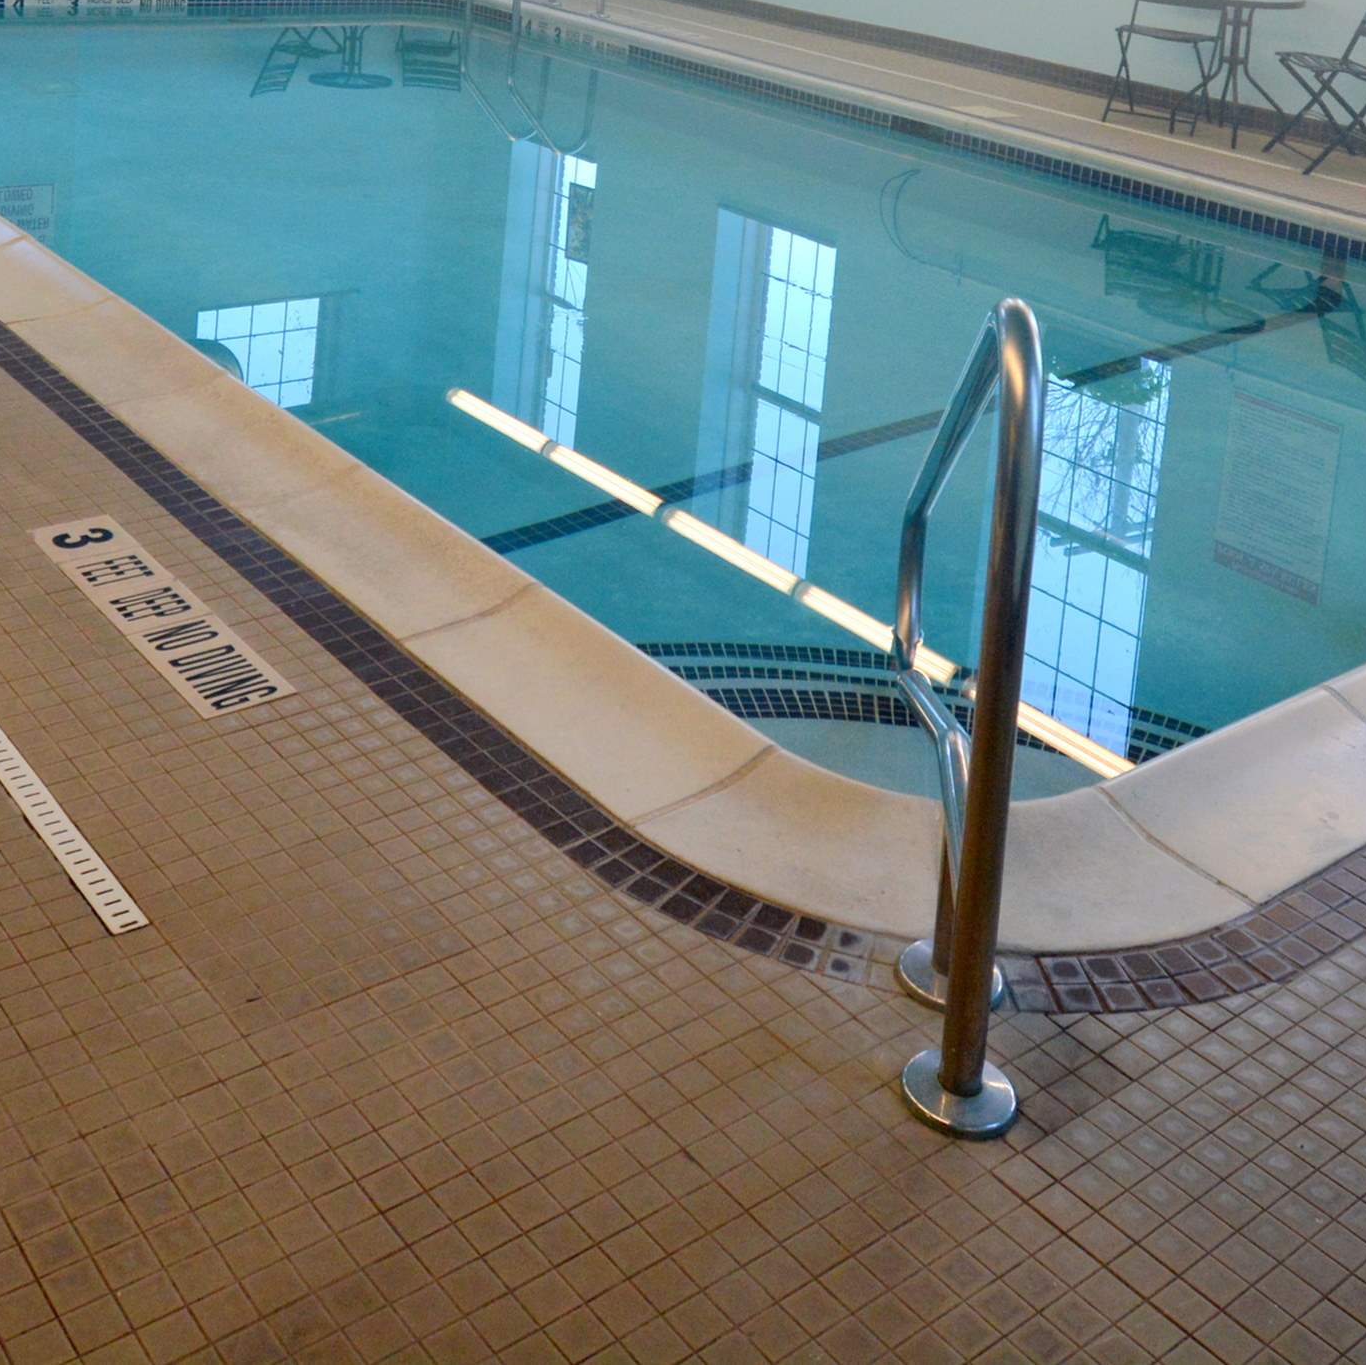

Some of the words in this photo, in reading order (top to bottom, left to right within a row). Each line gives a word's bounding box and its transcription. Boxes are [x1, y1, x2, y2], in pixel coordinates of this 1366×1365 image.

[52, 527, 114, 549] 3
[75, 554, 155, 587] FEET
[109, 586, 192, 622] DEEP
[142, 619, 219, 651] NO
[168, 644, 278, 710] DIVING
